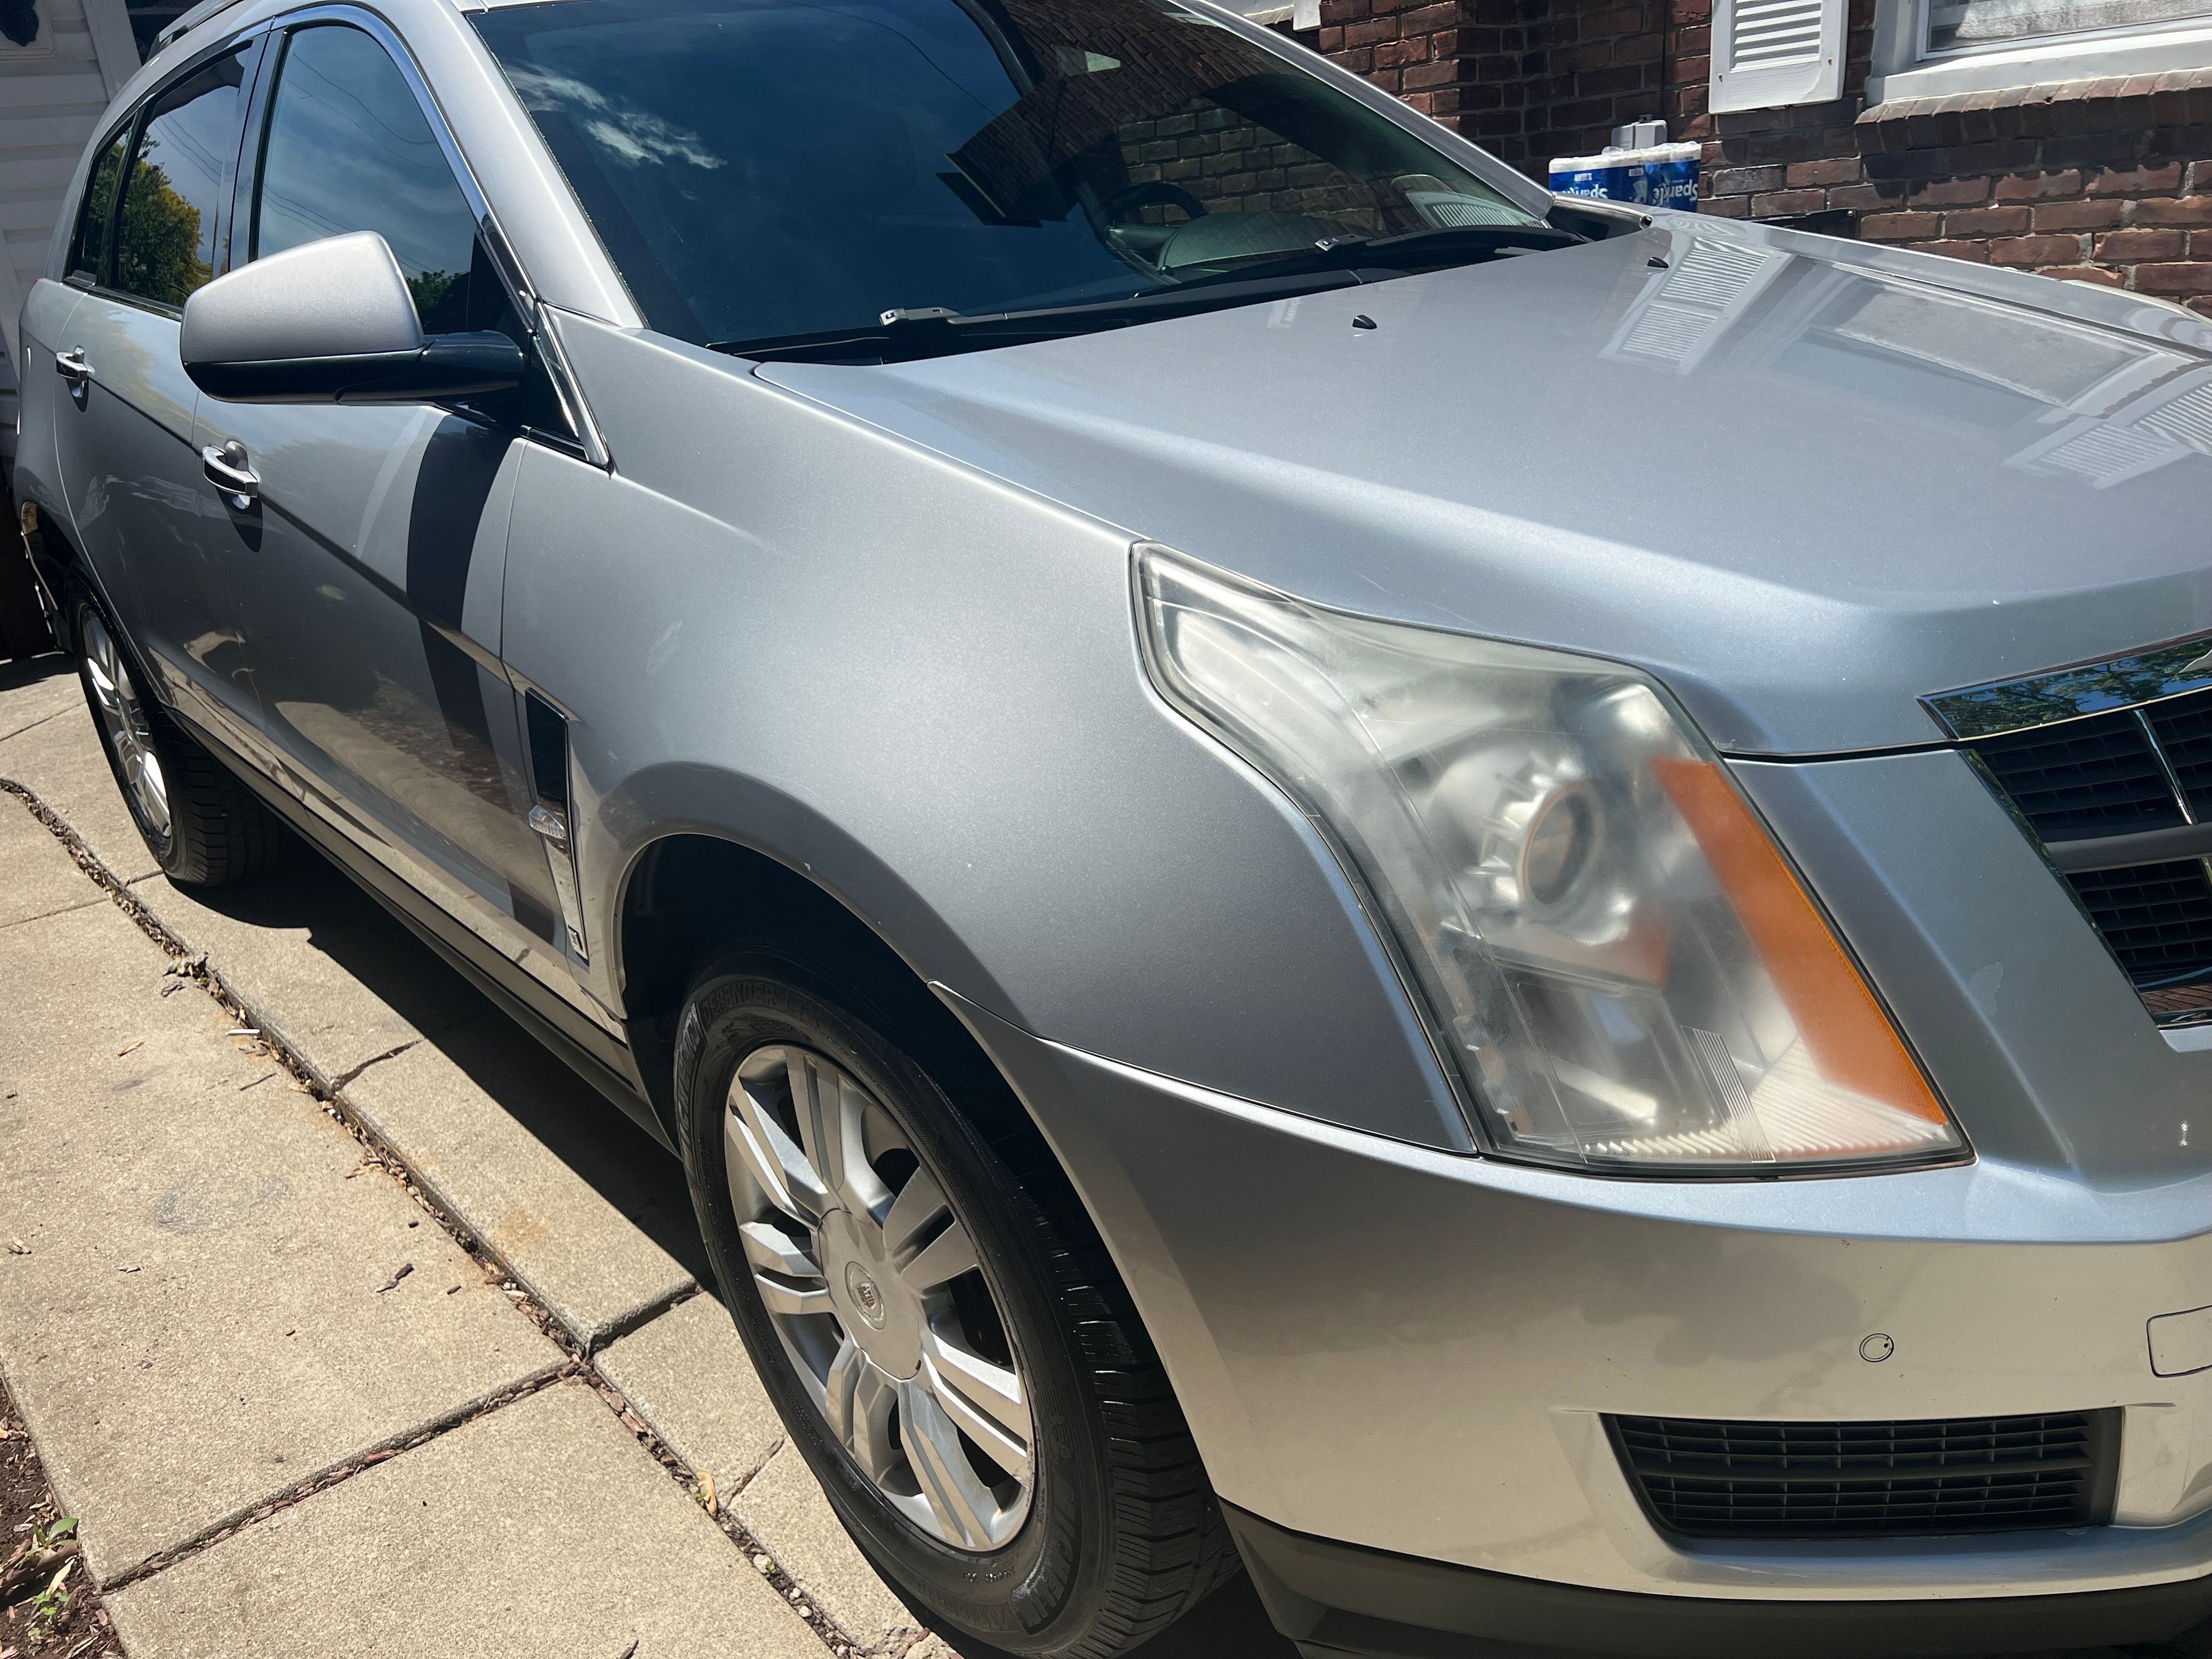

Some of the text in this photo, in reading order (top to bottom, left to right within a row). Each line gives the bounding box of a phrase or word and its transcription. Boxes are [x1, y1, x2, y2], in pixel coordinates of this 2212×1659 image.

[1652, 179, 1699, 205] Sparkle
[703, 981, 777, 1025] DEFENDER
[1016, 1468, 1076, 1627] MICHELIN
